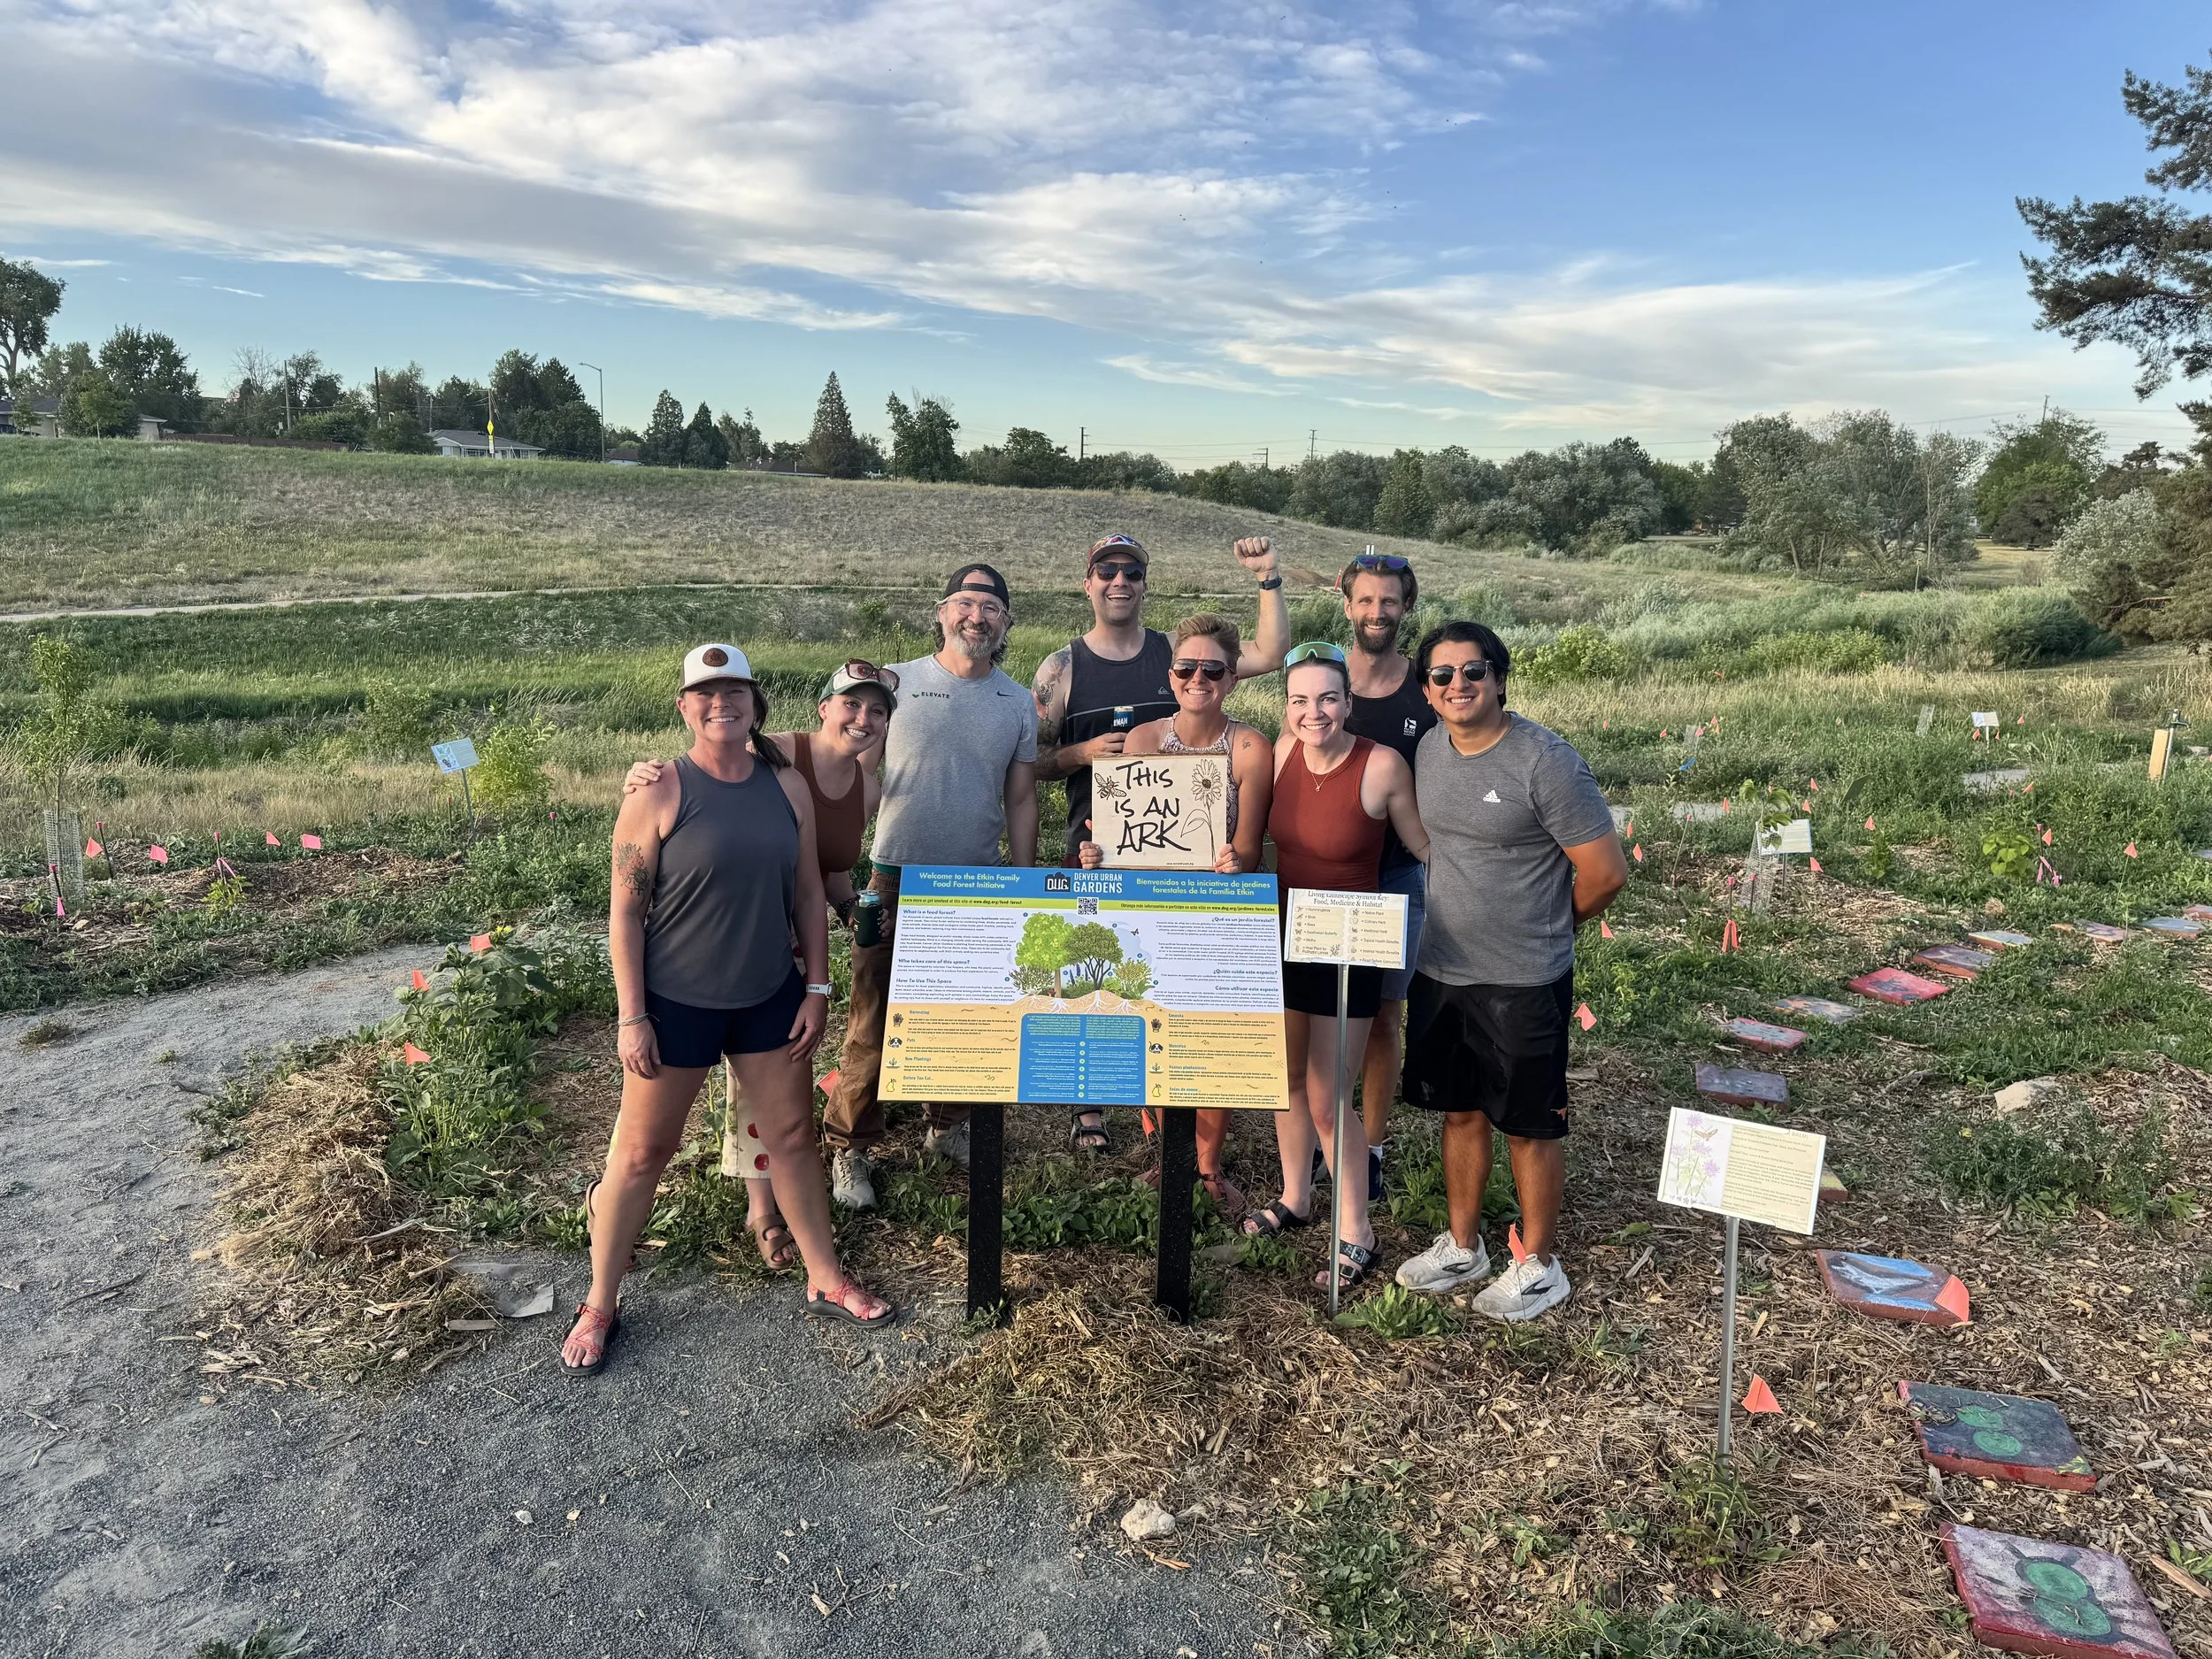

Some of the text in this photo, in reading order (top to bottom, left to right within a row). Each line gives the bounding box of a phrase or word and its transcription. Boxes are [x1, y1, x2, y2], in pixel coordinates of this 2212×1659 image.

[1116, 760, 1173, 790] THIS
[1115, 796, 1180, 818] IS AN
[1117, 819, 1192, 855] ARK
[996, 874, 1020, 883] Family
[1074, 872, 1099, 881] DENVER
[1047, 879, 1069, 890] DUG
[1073, 882, 1123, 894] GARDENS
[1241, 880, 1271, 889] jardines
[1308, 890, 1326, 899] Living
